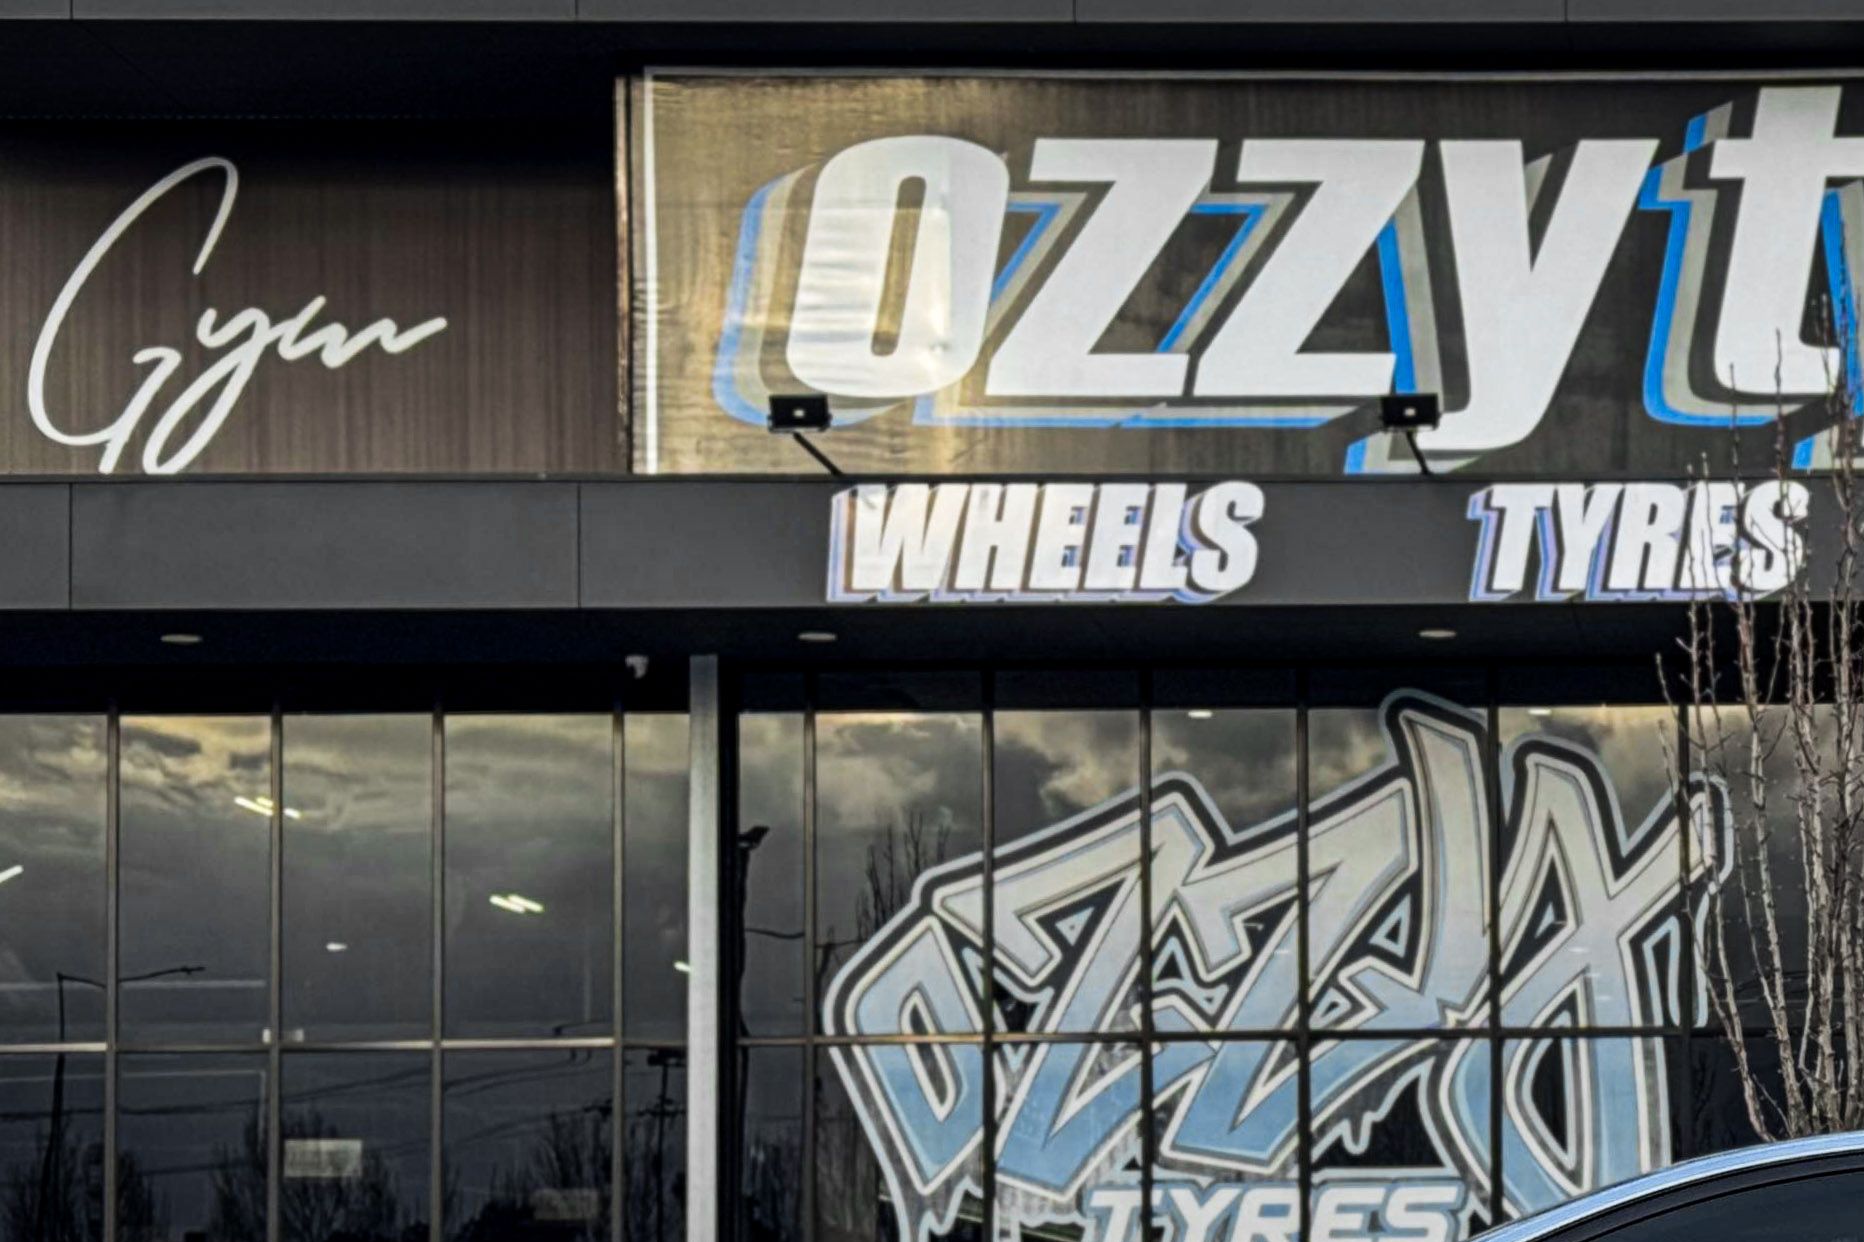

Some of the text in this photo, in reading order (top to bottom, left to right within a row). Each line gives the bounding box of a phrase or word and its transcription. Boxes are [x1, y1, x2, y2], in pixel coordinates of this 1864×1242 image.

[28, 156, 448, 474] Gym
[838, 483, 1264, 596] WHEELS
[1485, 483, 1808, 594] TYRES
